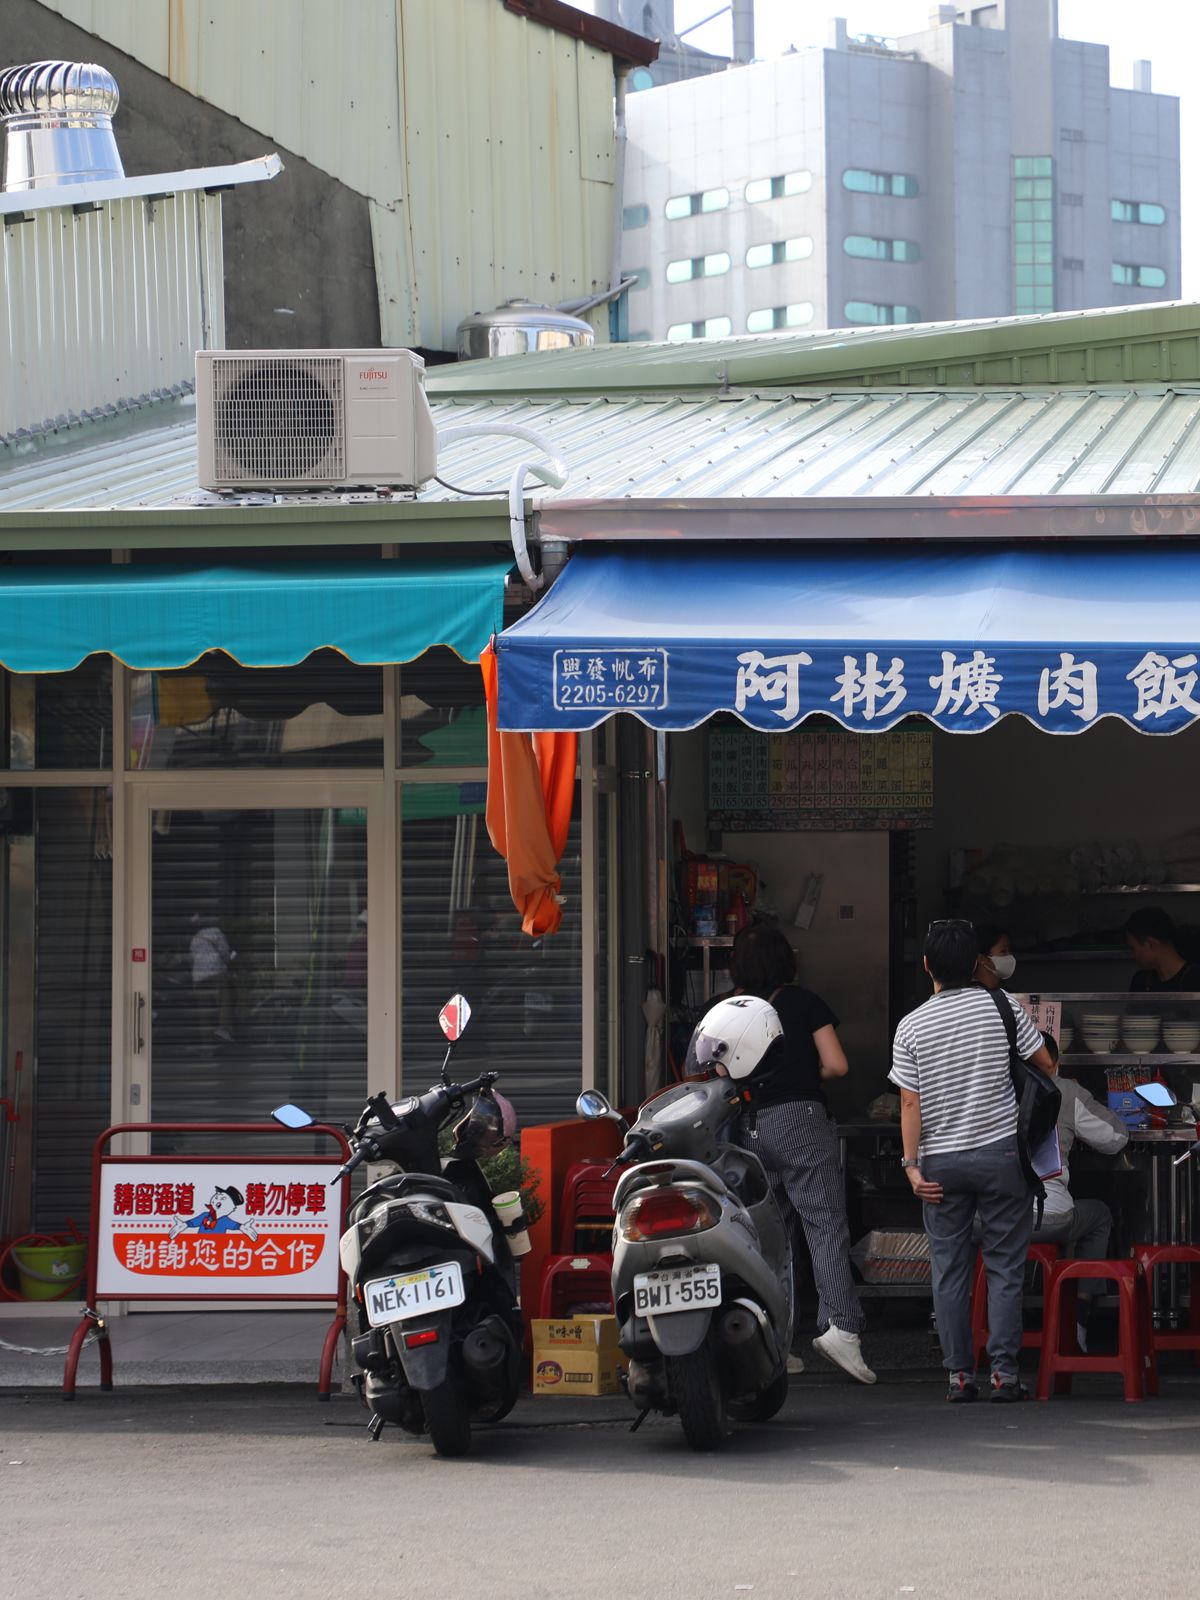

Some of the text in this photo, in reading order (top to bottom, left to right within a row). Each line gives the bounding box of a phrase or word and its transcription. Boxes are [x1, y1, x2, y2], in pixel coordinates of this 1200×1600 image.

[359, 370, 388, 381] FUJITSU
[561, 657, 659, 682] 興發帆布
[561, 684, 660, 704] 2205-6297
[113, 1182, 195, 1216] 請留通道
[245, 1182, 326, 1216] 請勿停車
[125, 1239, 316, 1271] 謝謝您的合作
